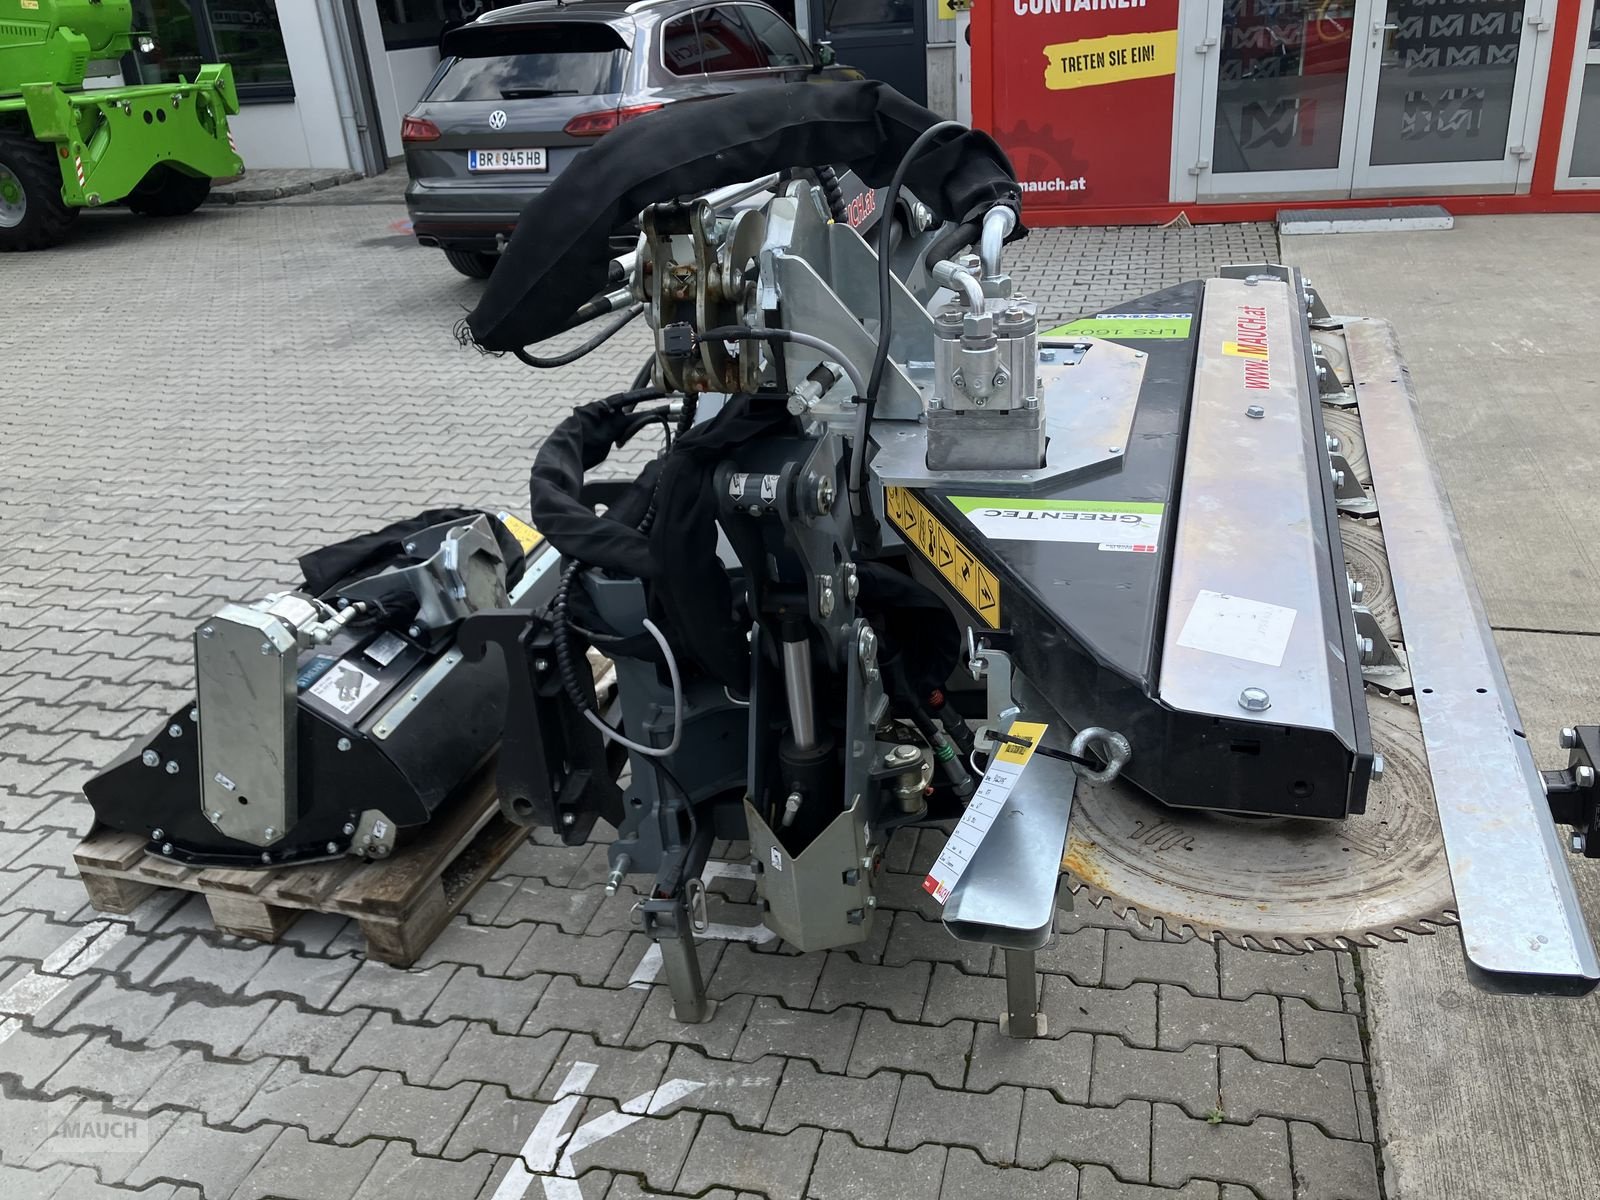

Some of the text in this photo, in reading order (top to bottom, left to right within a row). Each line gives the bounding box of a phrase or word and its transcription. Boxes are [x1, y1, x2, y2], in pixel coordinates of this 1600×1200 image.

[1013, 0, 1147, 16] CONTA
[1061, 45, 1155, 73] TRETEN SIE EIN!
[479, 152, 493, 166] BR
[1065, 328, 1178, 336] LRS 1602
